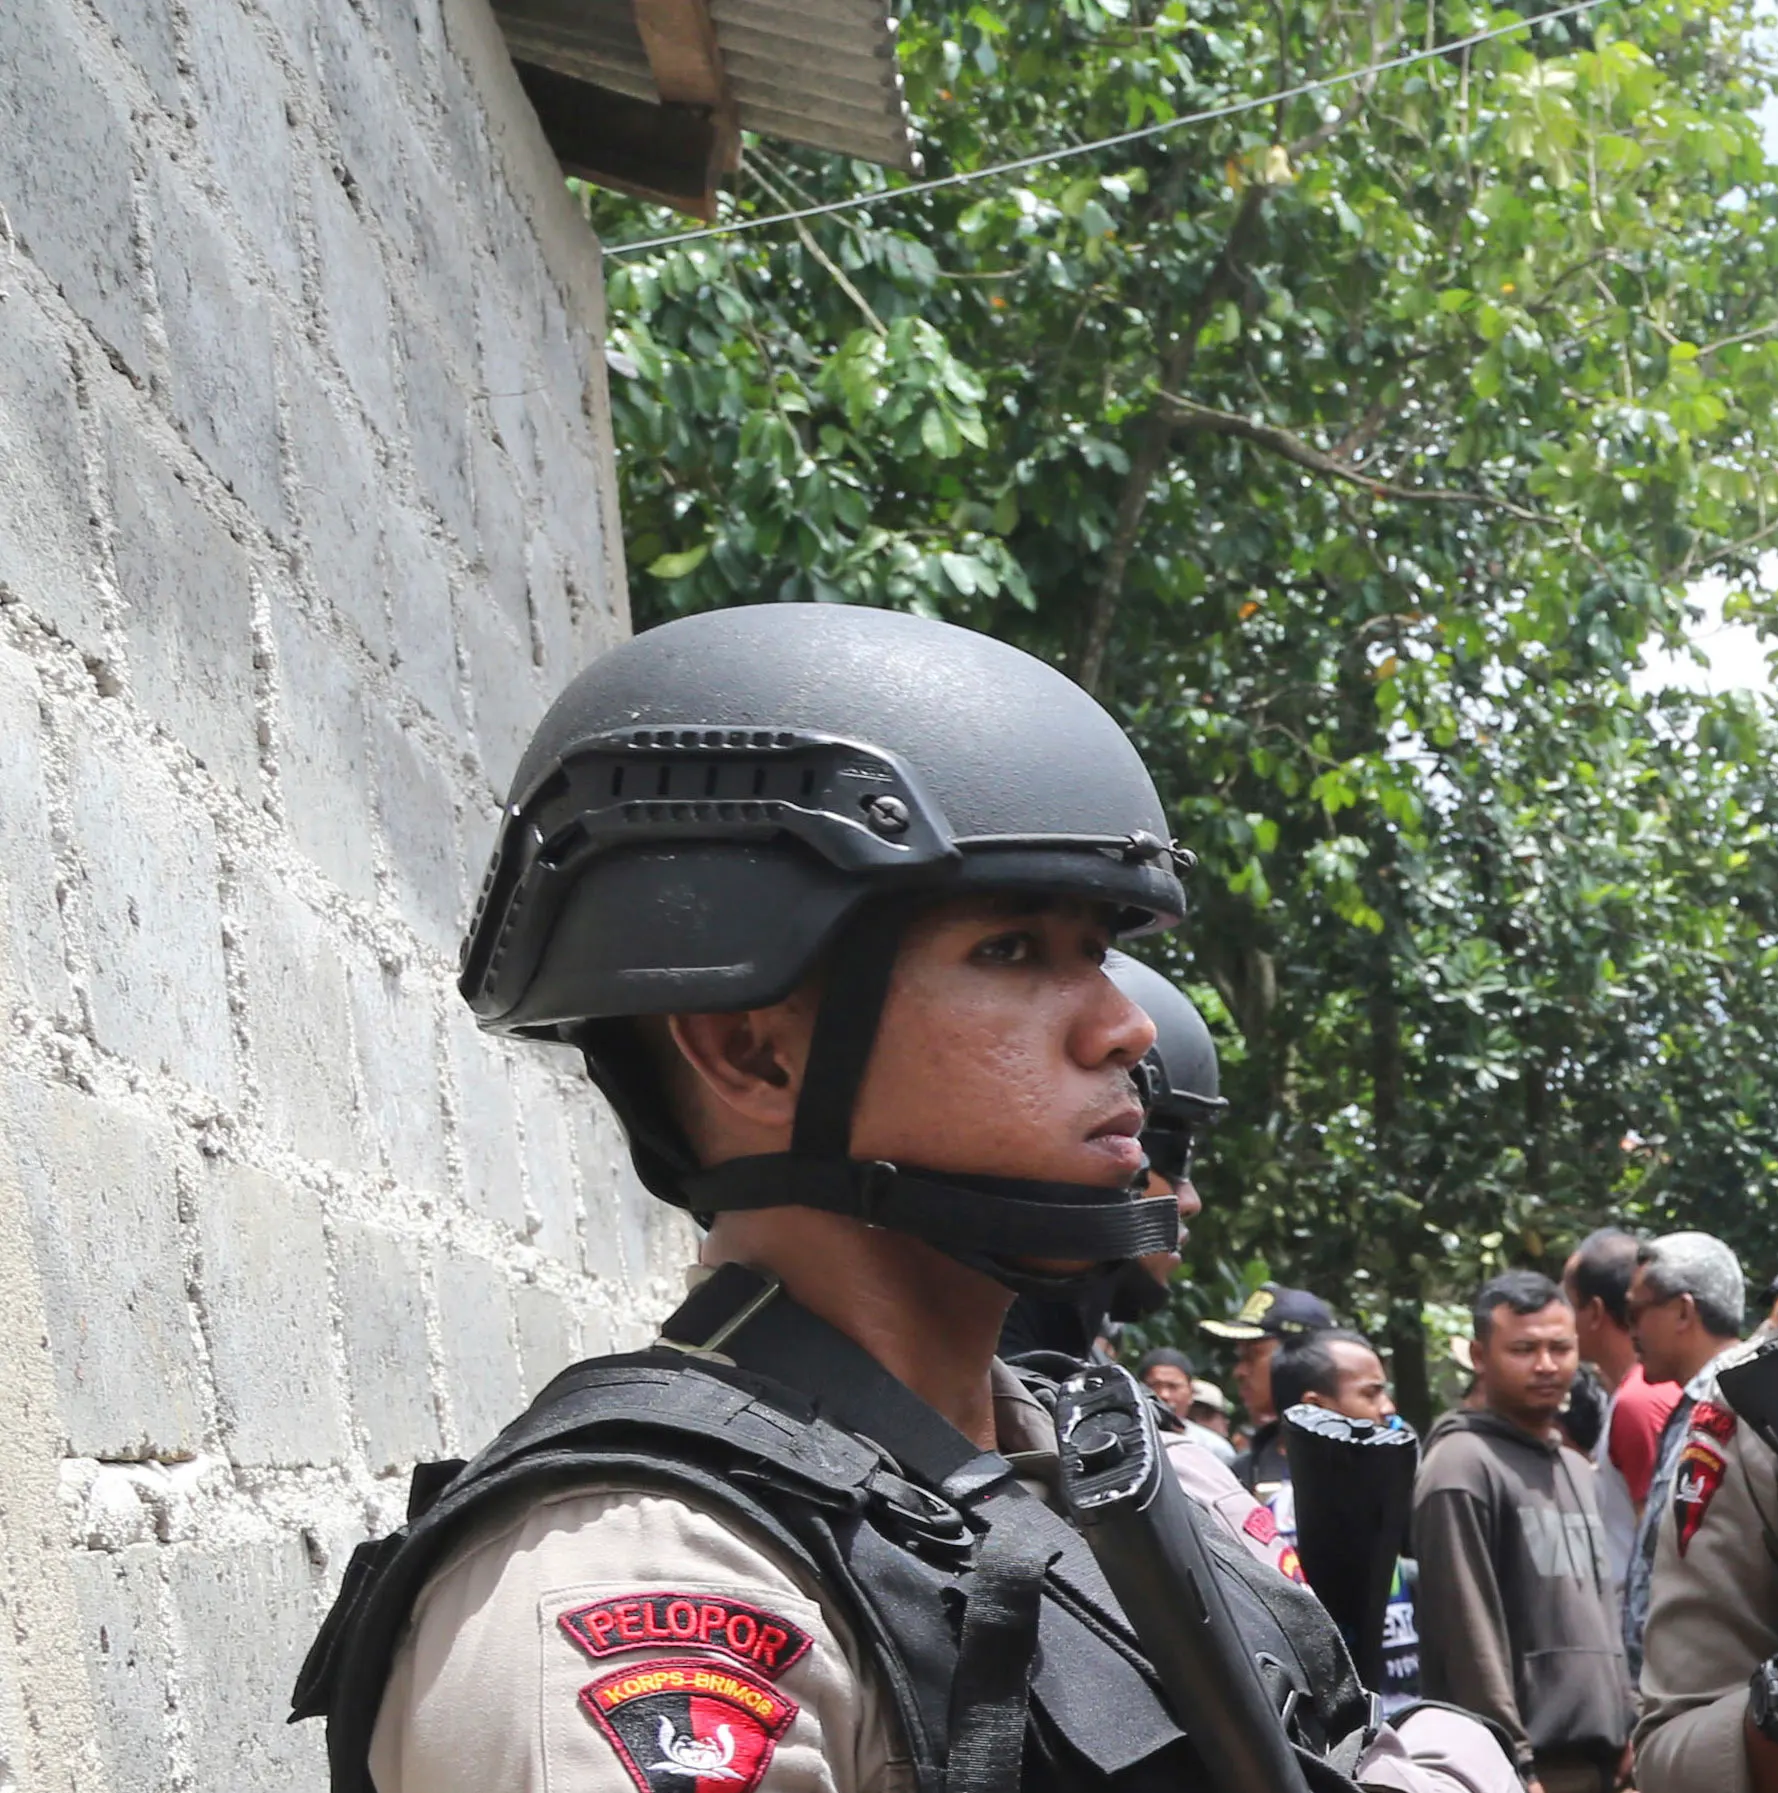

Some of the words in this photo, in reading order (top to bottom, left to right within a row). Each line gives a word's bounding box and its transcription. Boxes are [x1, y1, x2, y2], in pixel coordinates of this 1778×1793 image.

[581, 1600, 788, 1667] PELOPOR
[604, 1671, 685, 1705] KORPS
[693, 1673, 775, 1717] BRIMOB
